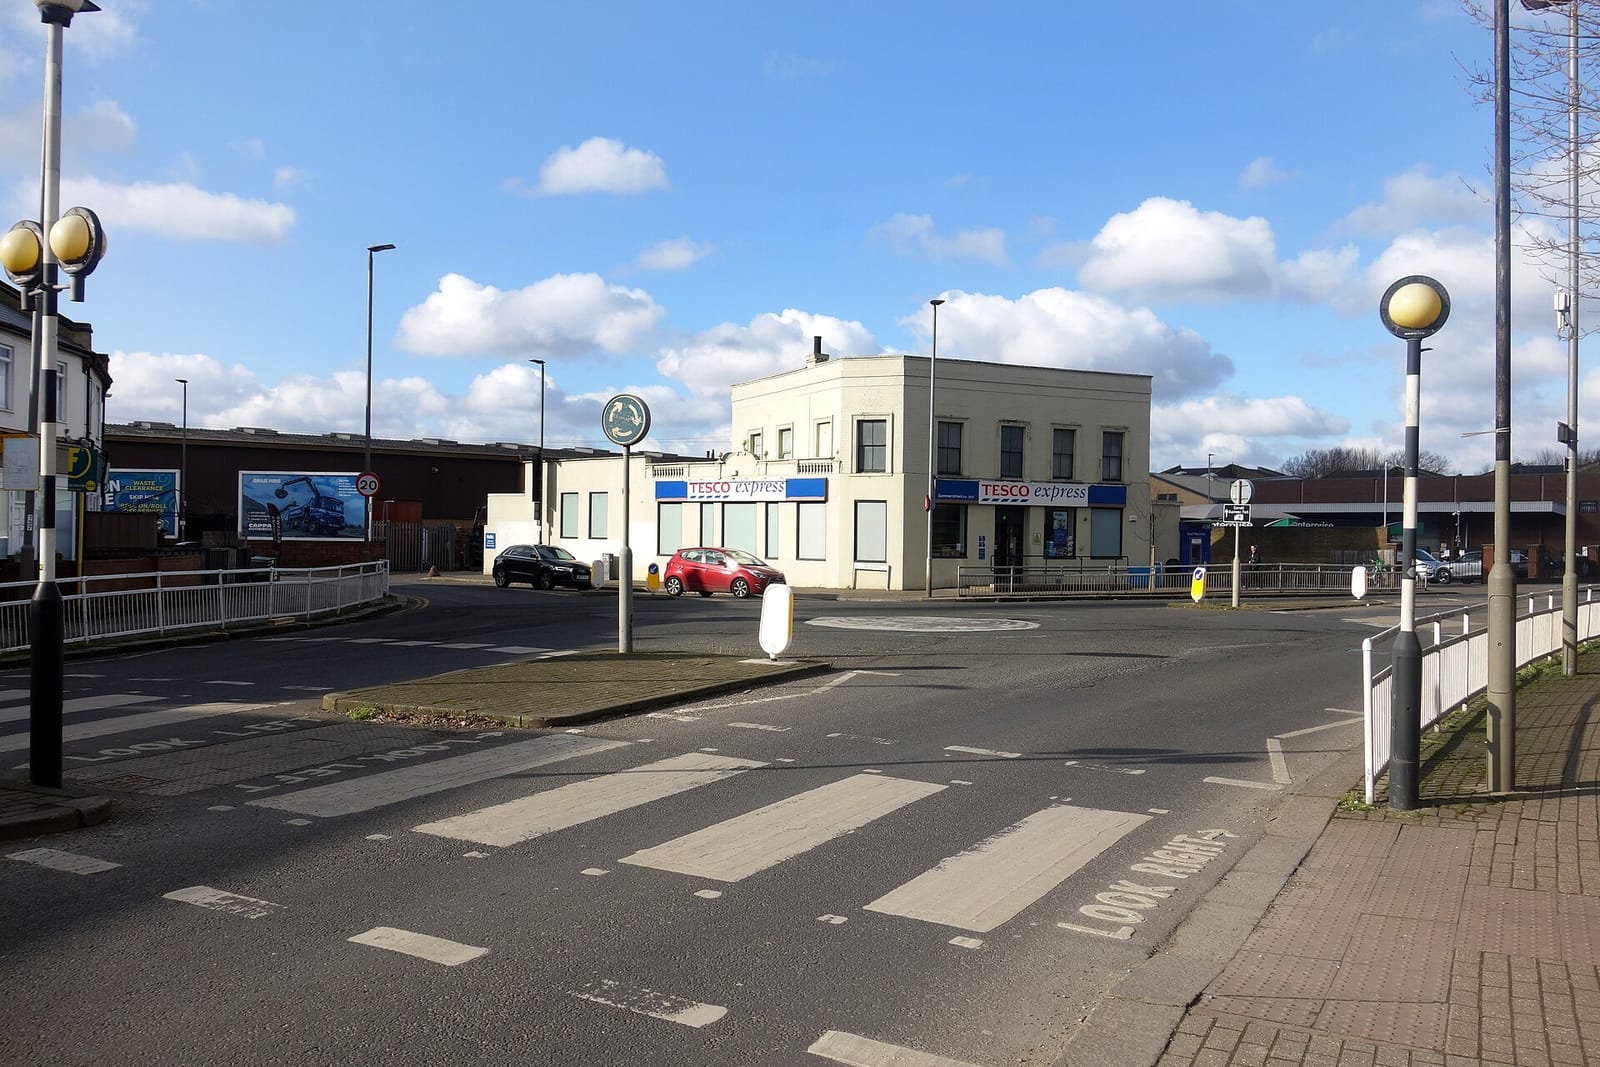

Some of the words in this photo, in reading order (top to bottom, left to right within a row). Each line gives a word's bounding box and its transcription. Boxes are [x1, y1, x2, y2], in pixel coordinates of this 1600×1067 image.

[359, 480, 377, 490] 20
[689, 482, 731, 494] TESCO
[735, 481, 785, 496] express
[982, 484, 1030, 497] TESCO
[1034, 486, 1086, 501] express
[62, 738, 206, 762] LOOK
[1057, 880, 1178, 940] LOOK
[1131, 834, 1226, 879] RIGHT
